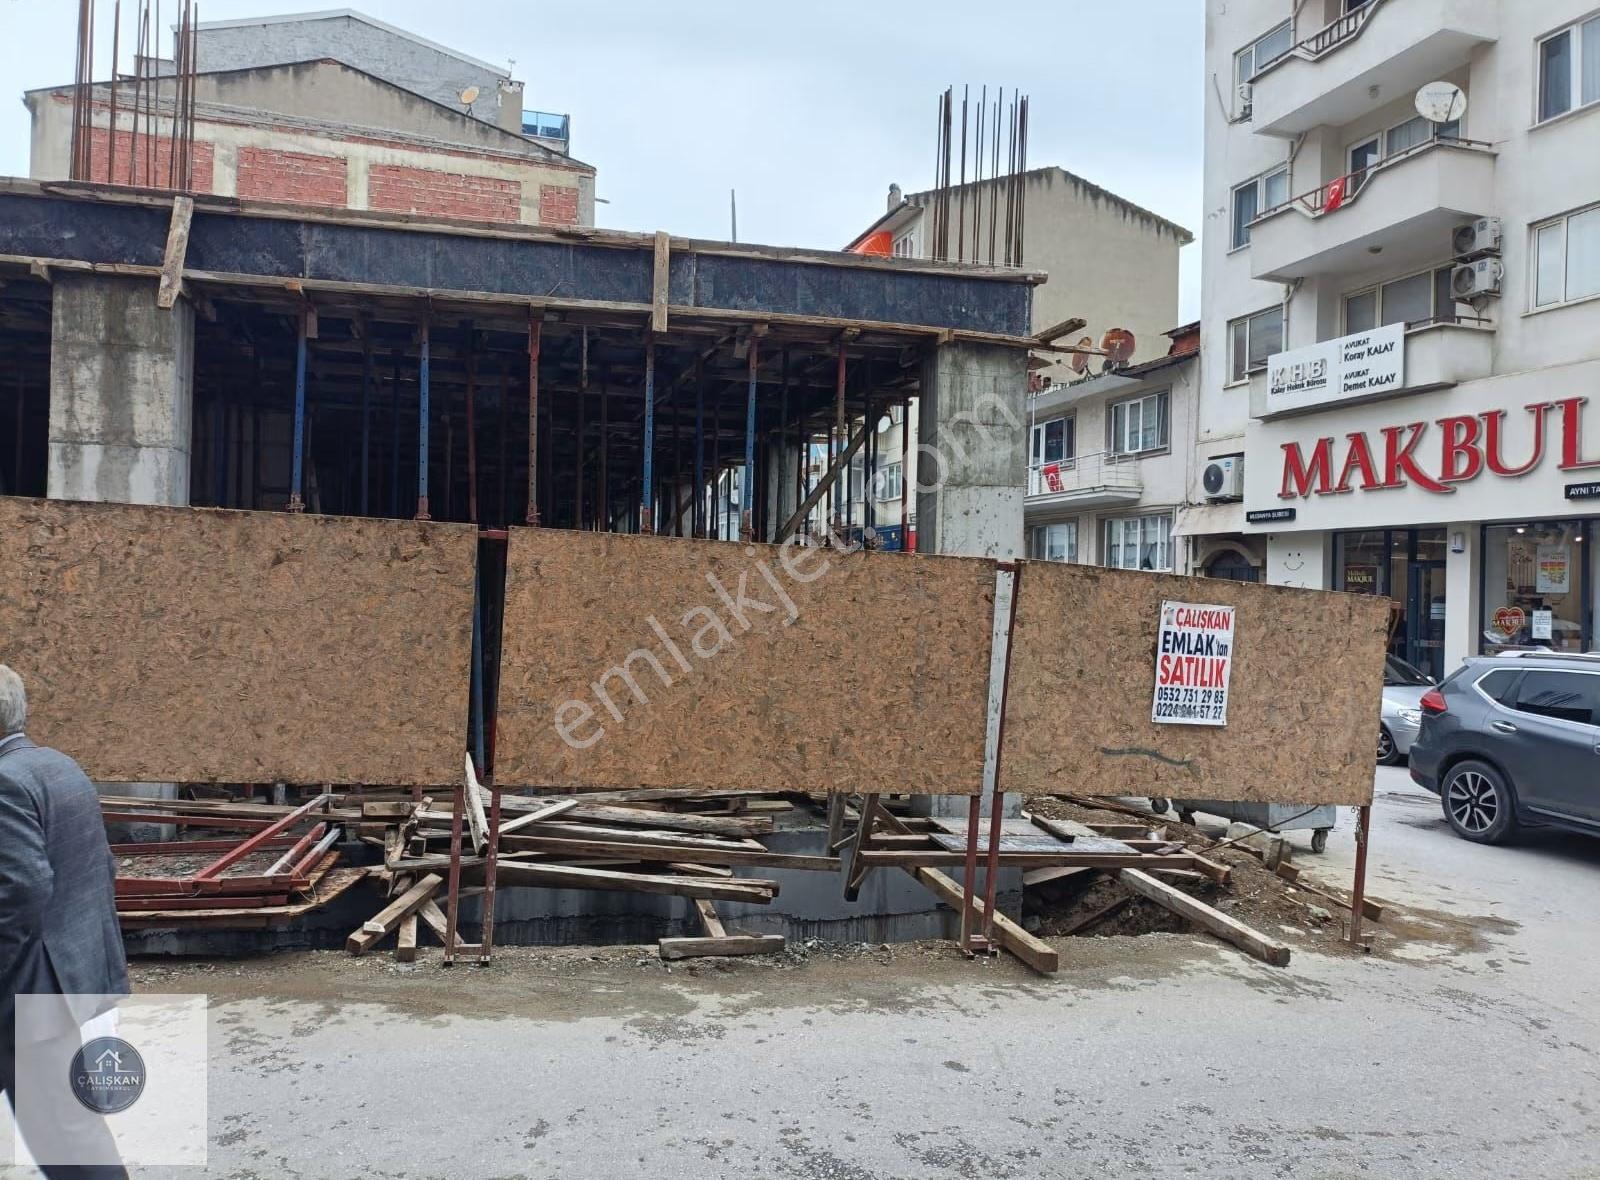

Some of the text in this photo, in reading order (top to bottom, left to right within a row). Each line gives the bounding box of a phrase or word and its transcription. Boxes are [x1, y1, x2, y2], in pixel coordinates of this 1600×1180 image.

[1344, 342, 1395, 362] Koray KALAY
[1345, 338, 1370, 349] AVUKAT
[1344, 368, 1369, 379] AVUKAT
[1343, 373, 1396, 392] Demet KALAY
[1278, 396, 1600, 500] MAKBUL
[1570, 487, 1589, 495] AYNI
[1176, 608, 1230, 633] ÇALIŞKAN
[1160, 655, 1226, 688] SATILIK
[1157, 687, 1180, 701] 0532
[1183, 689, 1198, 703] 731
[1202, 690, 1212, 703] 29
[1156, 703, 1178, 717] 0224
[1200, 705, 1210, 719] 57
[1213, 705, 1223, 719] 27
